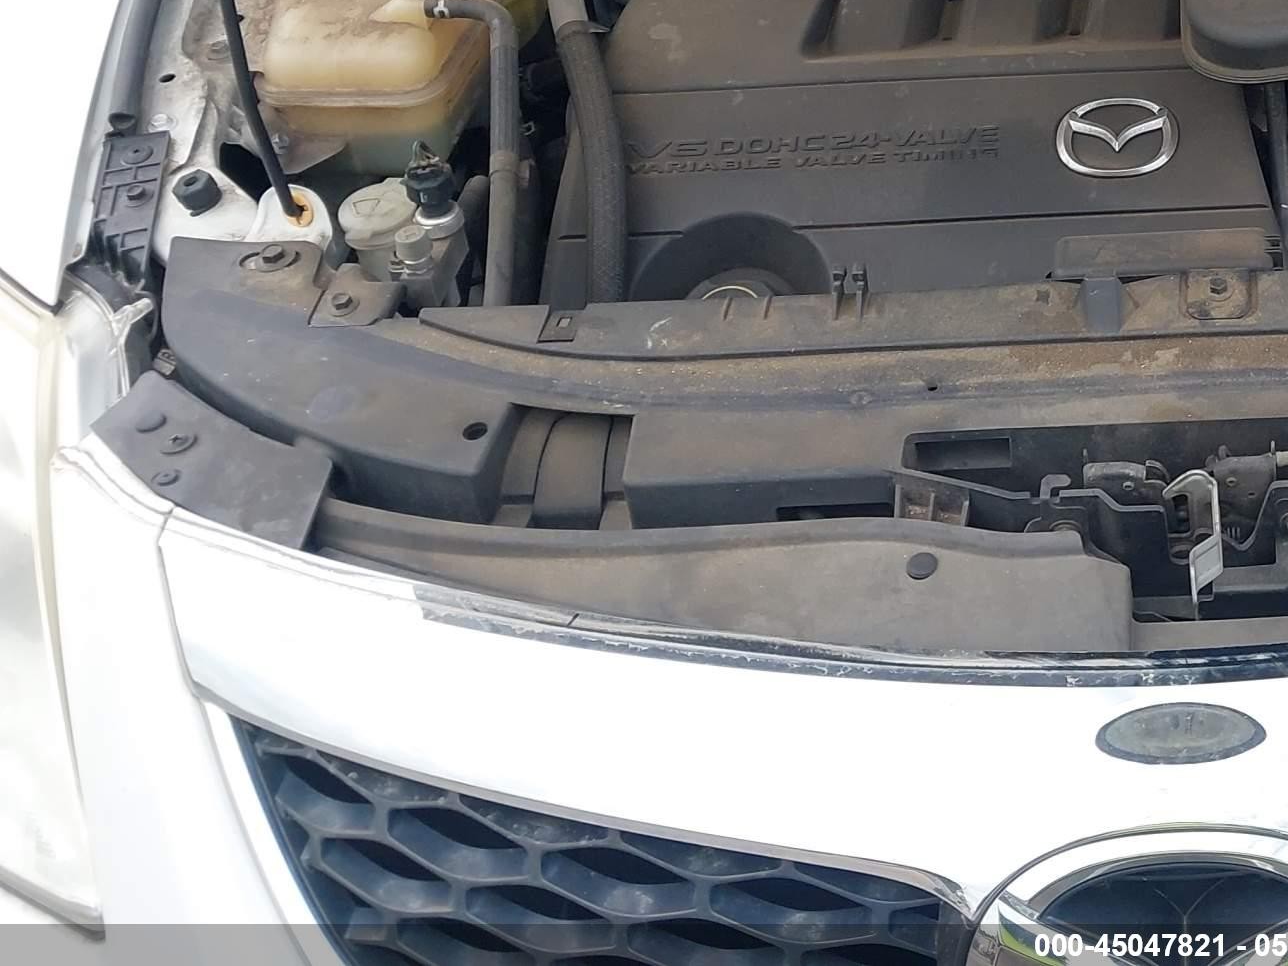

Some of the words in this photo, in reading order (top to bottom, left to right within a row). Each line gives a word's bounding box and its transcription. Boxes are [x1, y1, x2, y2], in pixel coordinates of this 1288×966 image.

[713, 135, 826, 156] DOHC
[831, 126, 1000, 150] 24-VALVE
[625, 158, 782, 174] VARIABLE
[795, 152, 887, 168] VALVE
[892, 147, 999, 163] TIMING
